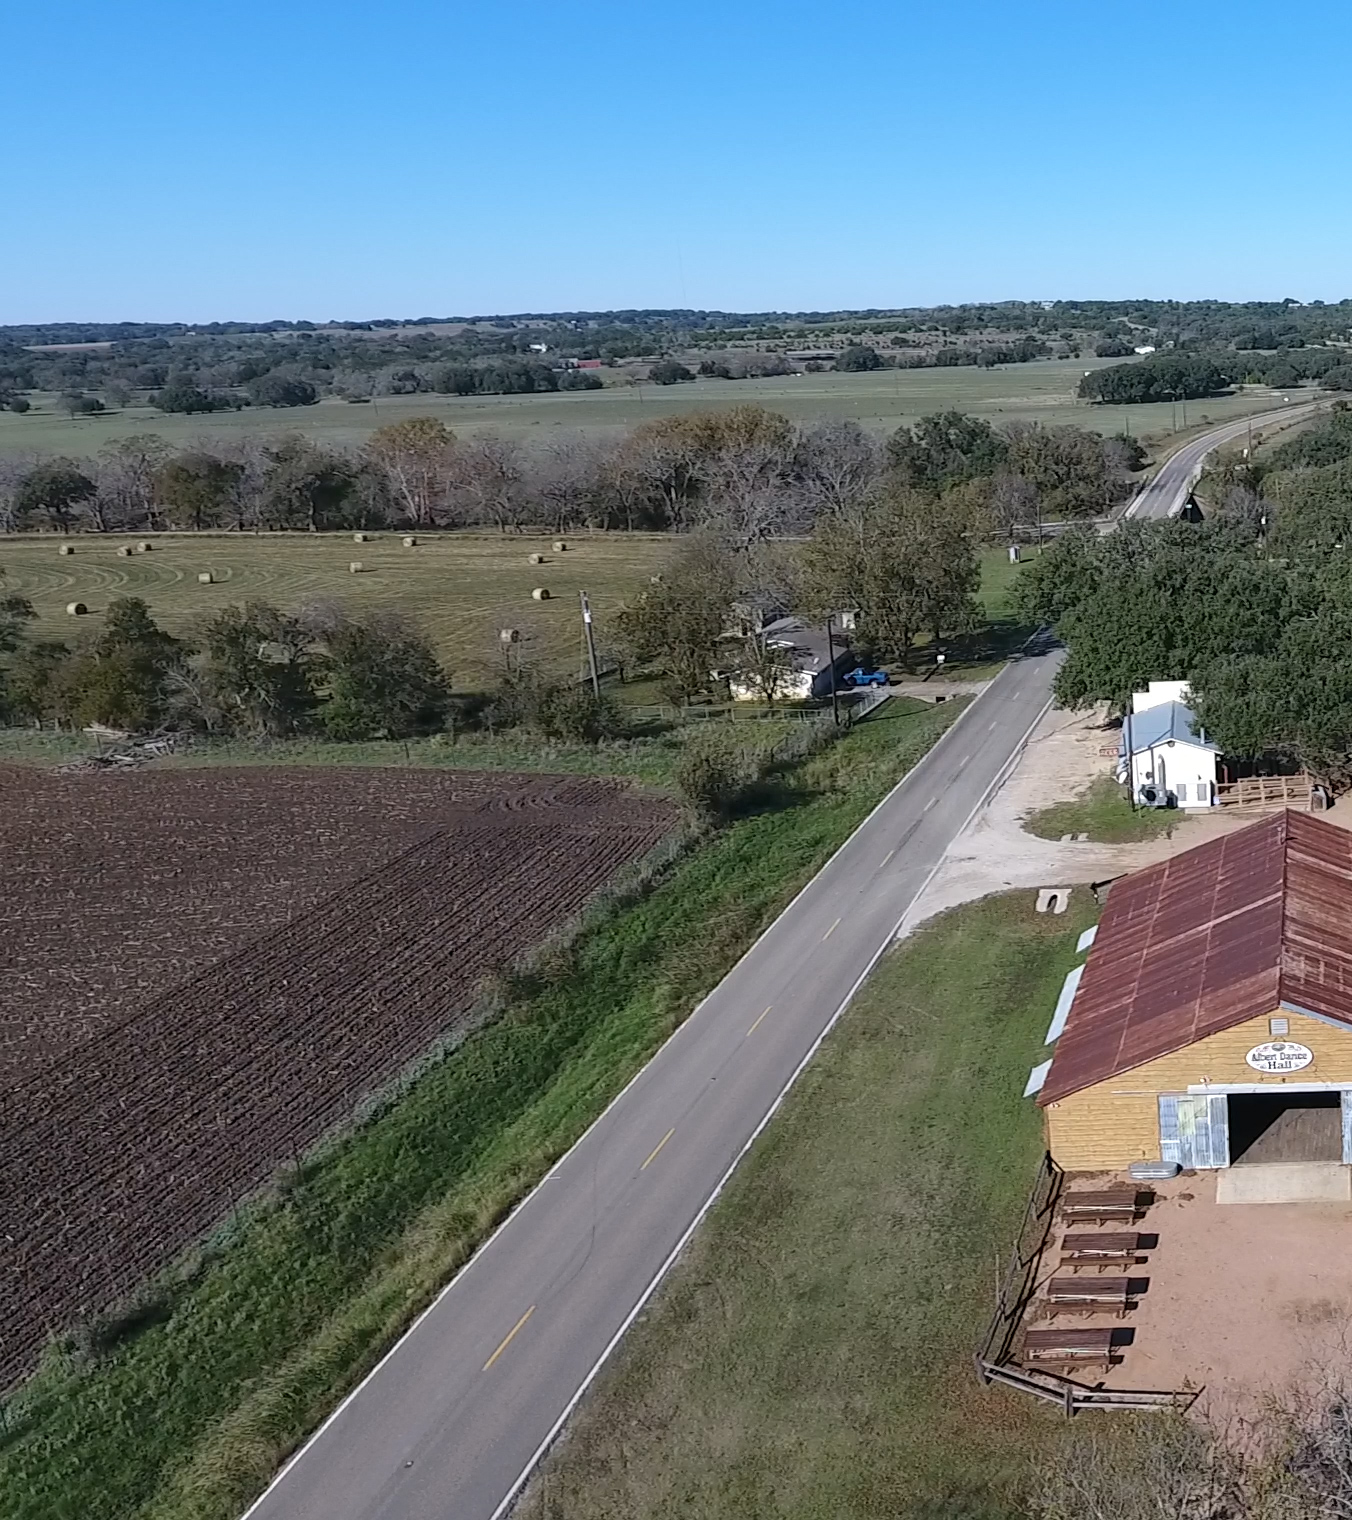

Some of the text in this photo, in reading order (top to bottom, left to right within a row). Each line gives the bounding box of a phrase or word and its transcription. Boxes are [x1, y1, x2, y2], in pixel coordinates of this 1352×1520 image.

[1251, 1052, 1307, 1061] Albert Dance
[1268, 1061, 1292, 1069] Hall
